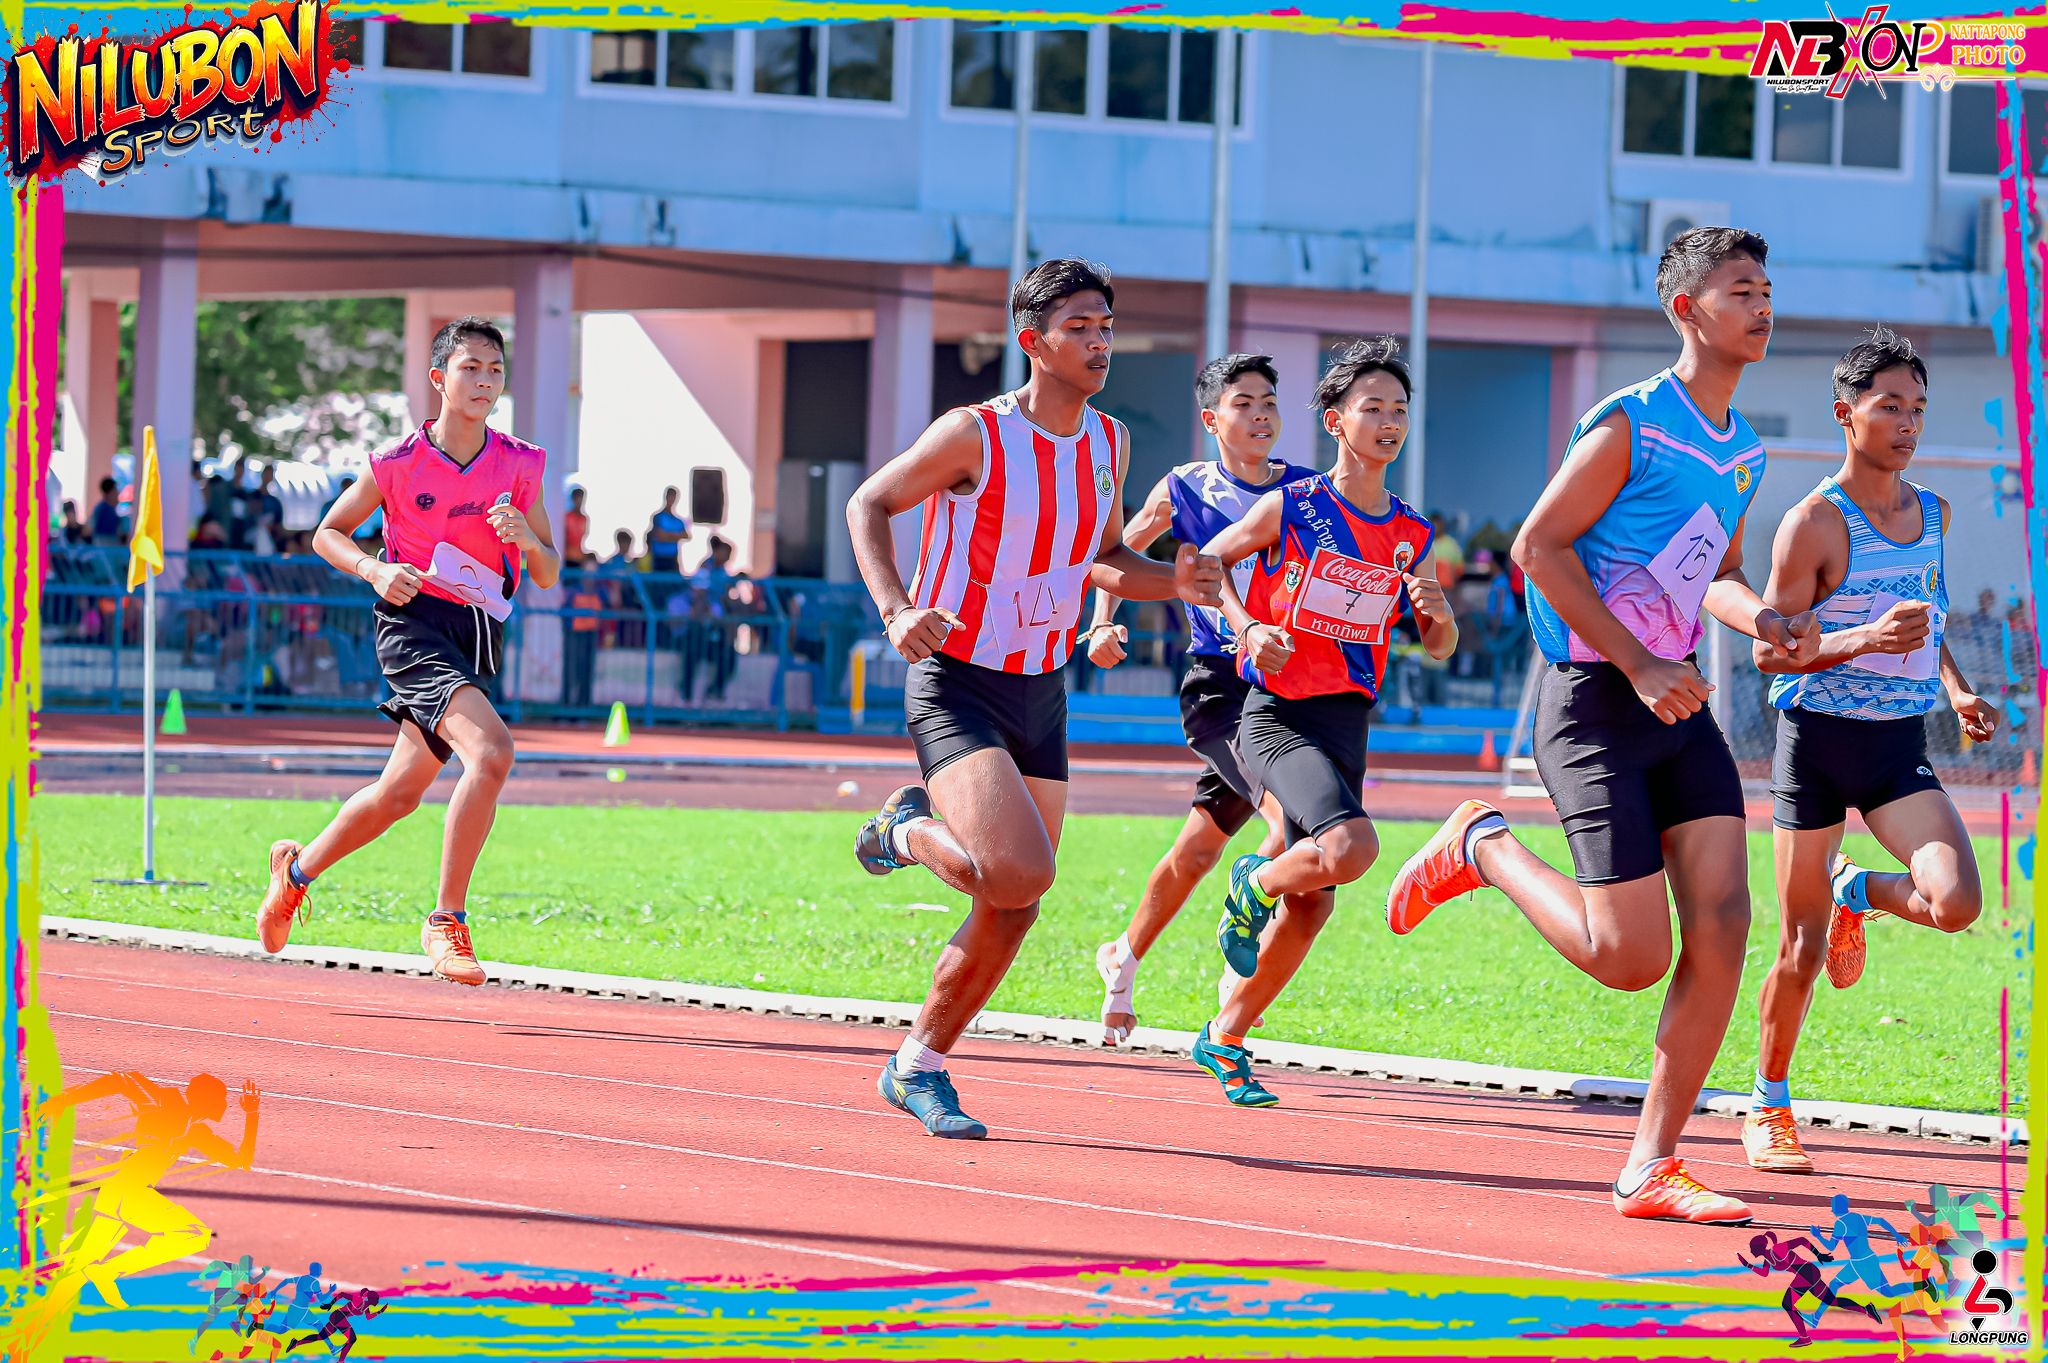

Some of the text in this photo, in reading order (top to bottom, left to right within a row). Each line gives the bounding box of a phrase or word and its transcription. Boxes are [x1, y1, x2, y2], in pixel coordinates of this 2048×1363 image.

[1675, 533, 1716, 582] 15
[1012, 581, 1059, 629] 14
[1345, 588, 1362, 614] 7
[1310, 617, 1371, 641] หาดทิพย์
